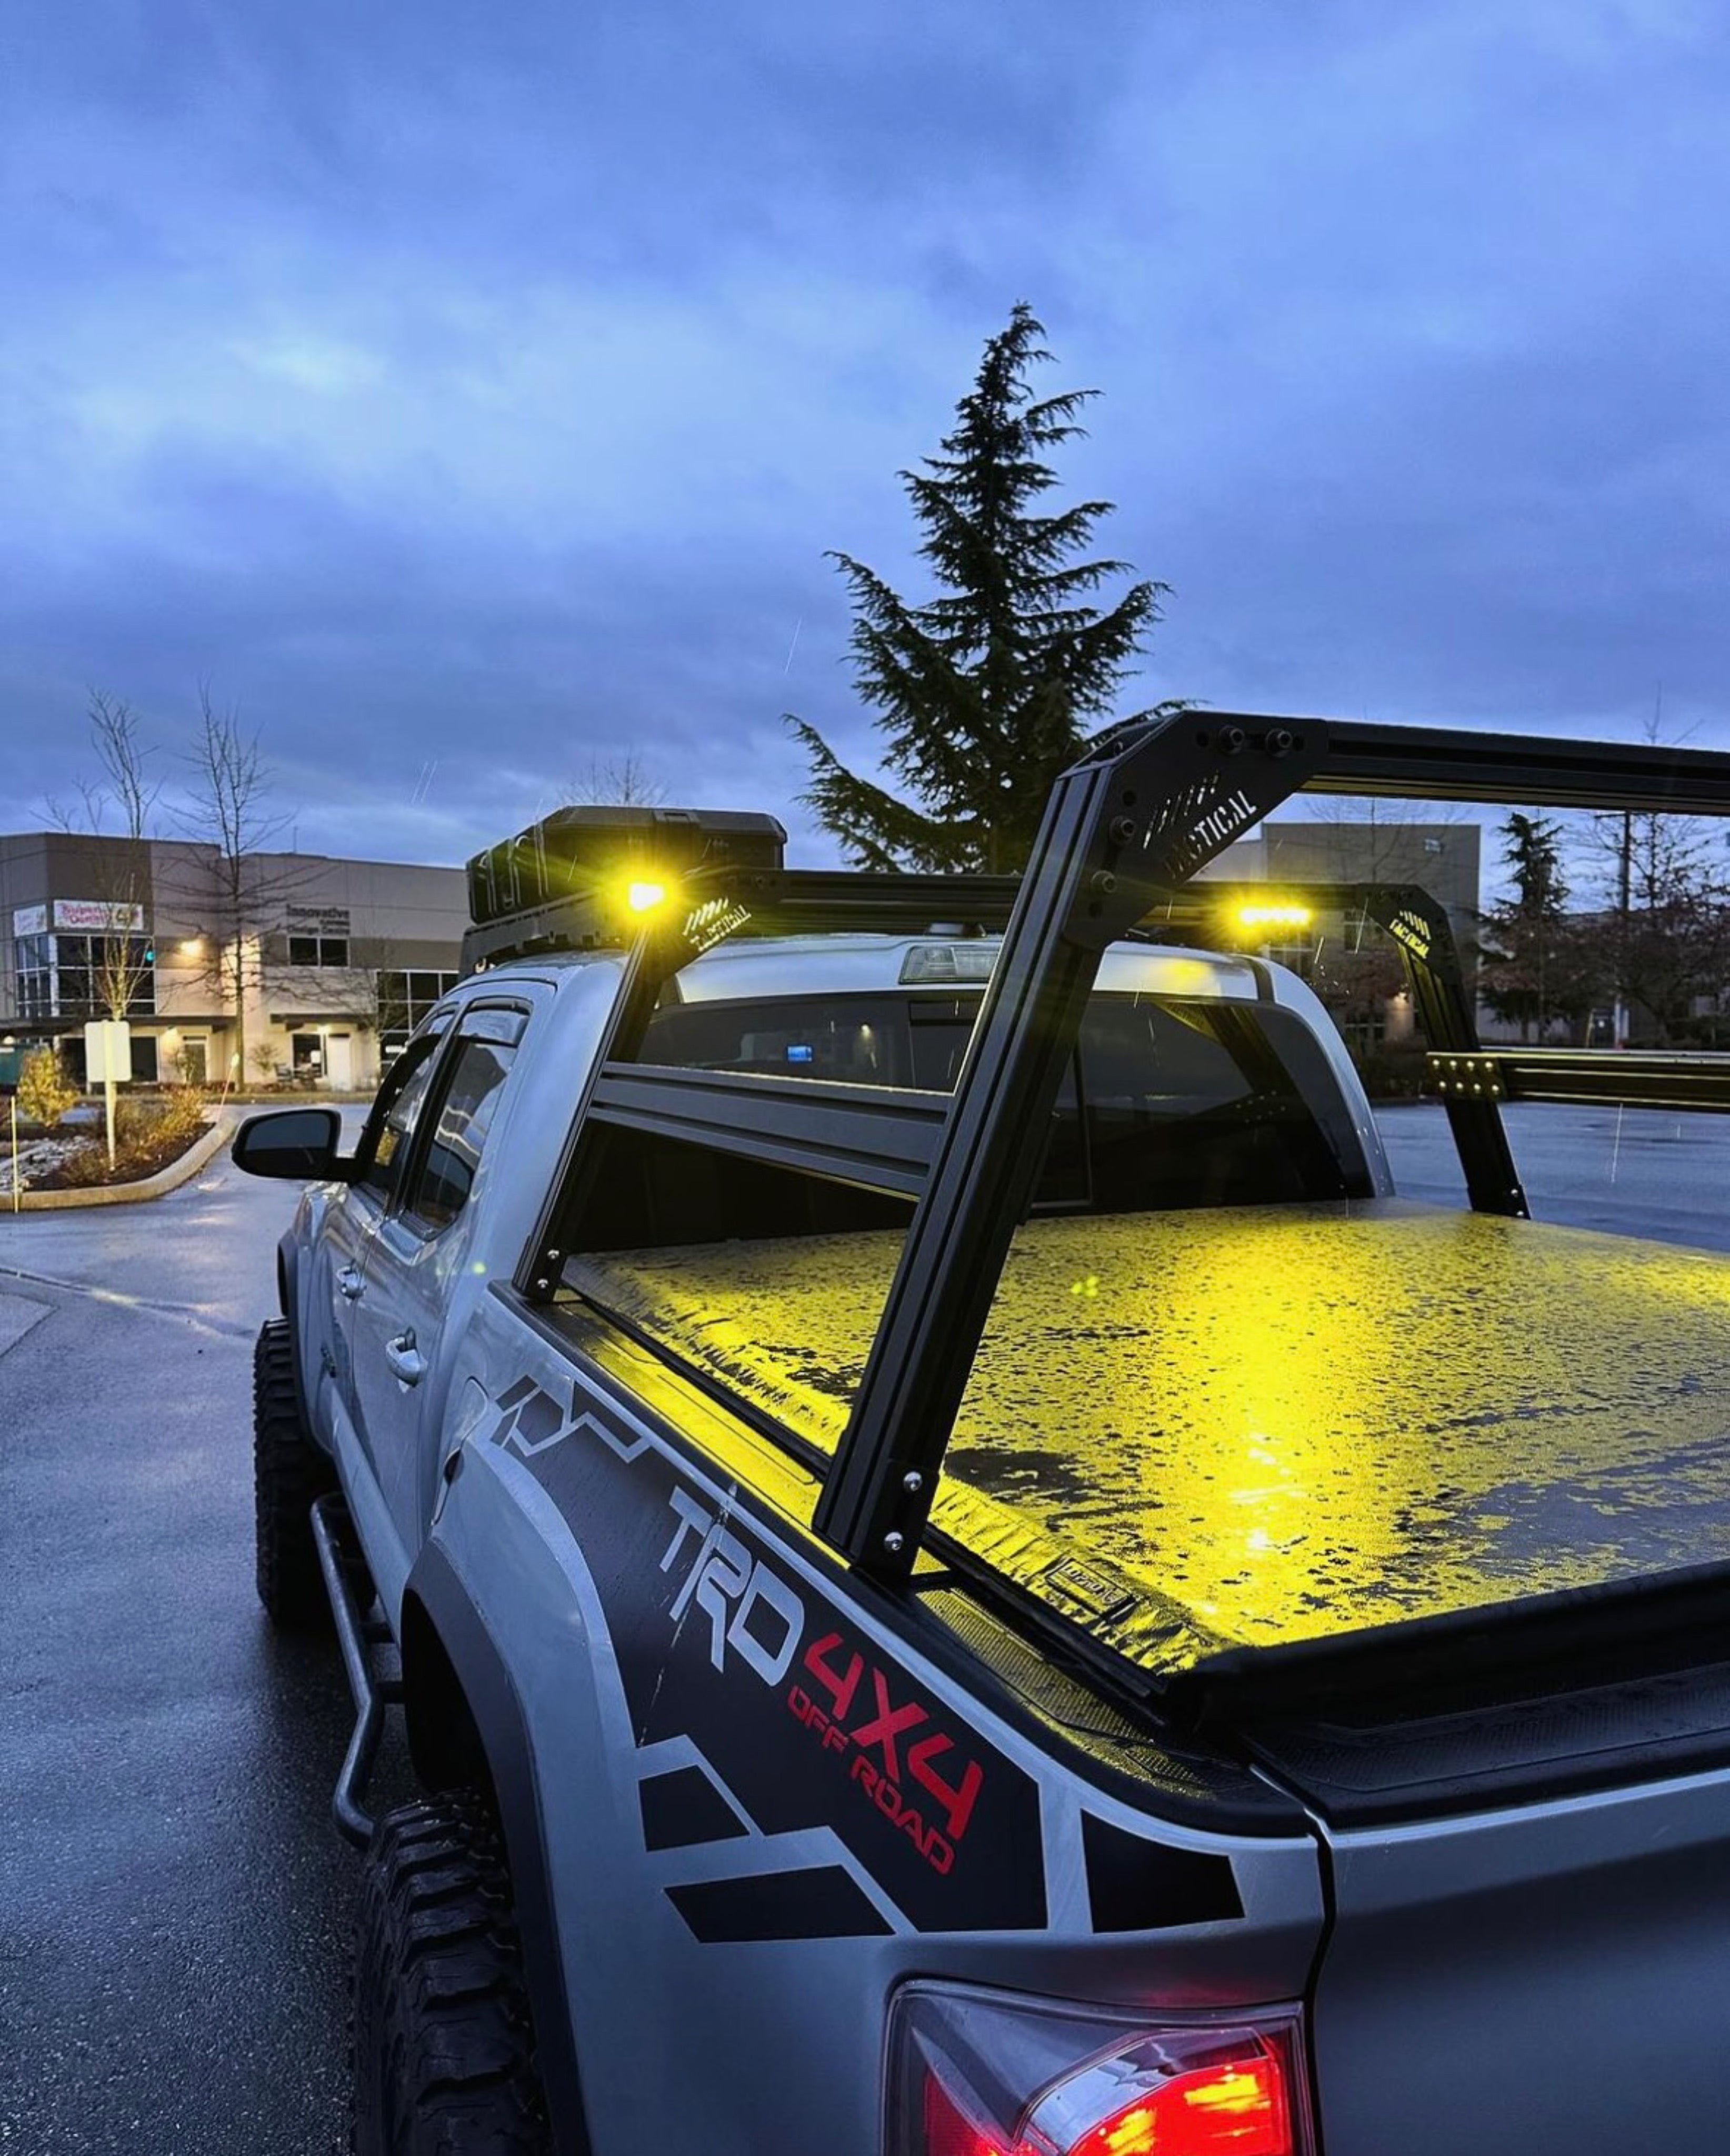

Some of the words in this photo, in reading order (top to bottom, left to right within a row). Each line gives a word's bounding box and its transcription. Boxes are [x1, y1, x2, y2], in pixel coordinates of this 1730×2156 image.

[659, 1485, 805, 1686] TRD
[787, 1685, 849, 1754] OFF
[851, 1755, 955, 1875] ROAD
